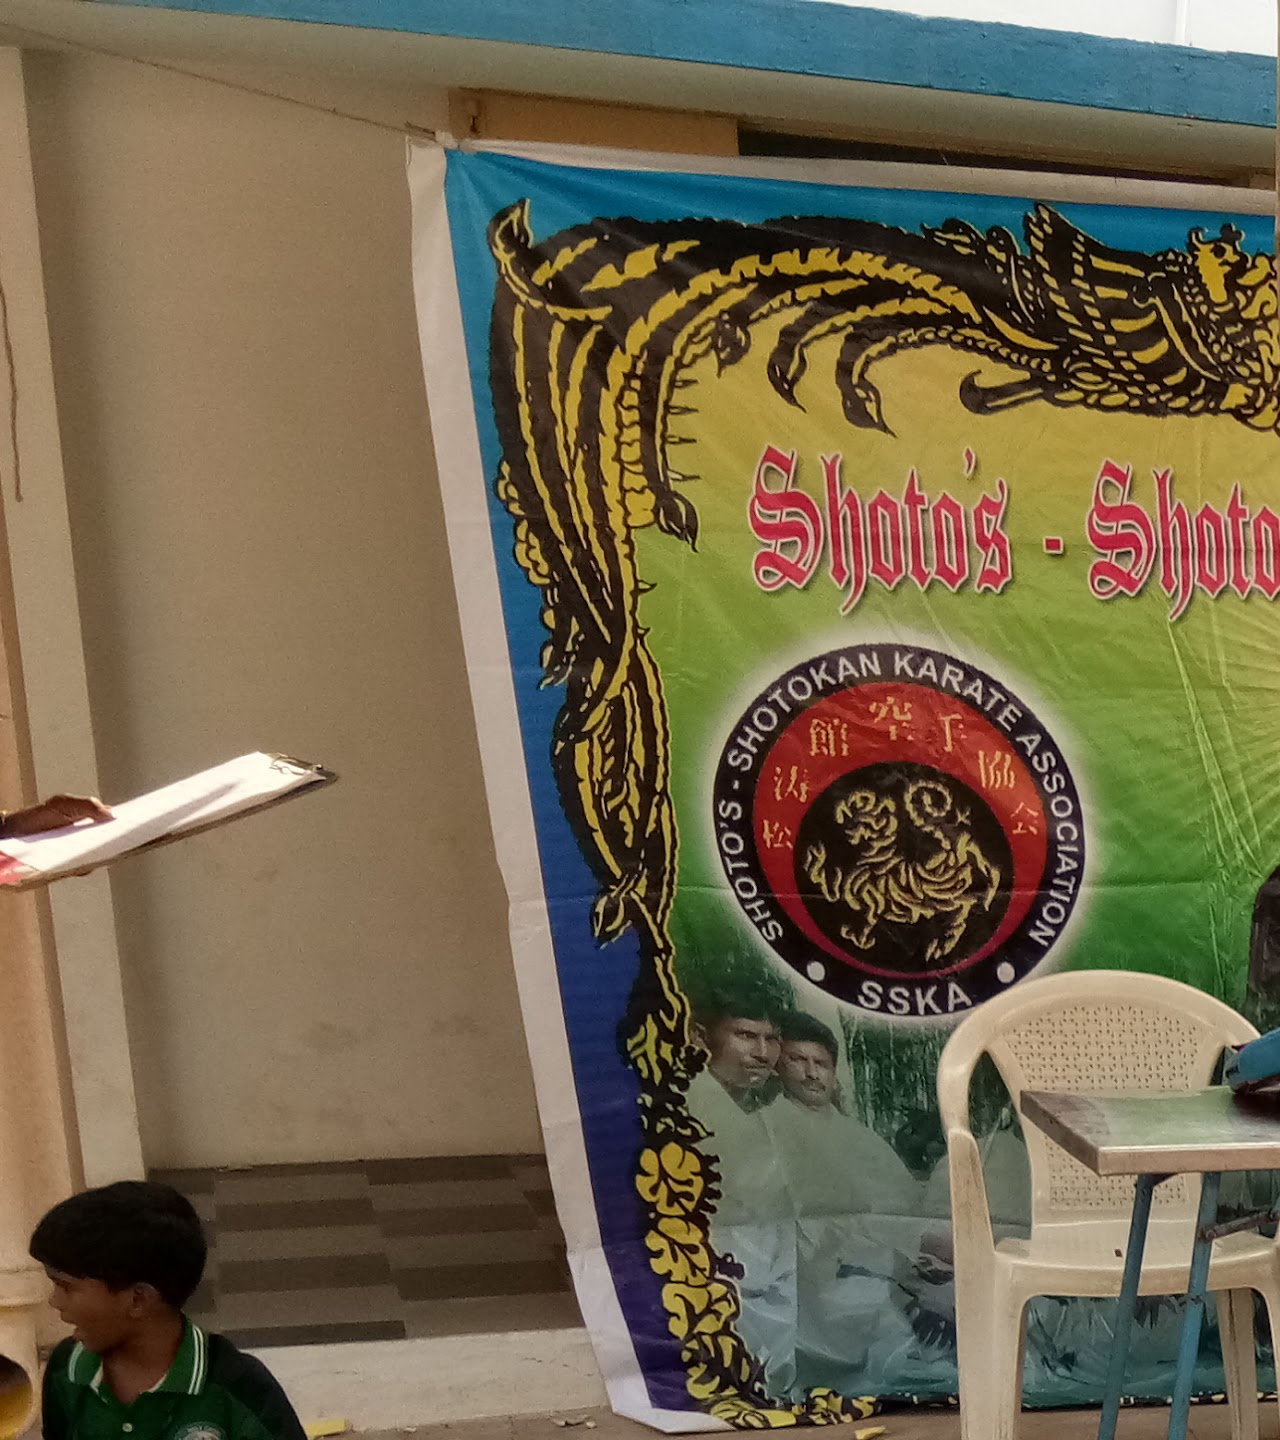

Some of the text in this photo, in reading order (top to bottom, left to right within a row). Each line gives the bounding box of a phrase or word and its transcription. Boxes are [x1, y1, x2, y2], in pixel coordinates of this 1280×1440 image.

[749, 444, 1012, 615] Shoto's
[728, 651, 882, 772] SHOTOKAN
[893, 650, 1024, 732] KARATE
[718, 800, 784, 943] SHOTO'S
[1016, 732, 1080, 948] ASSOCIATION
[857, 980, 973, 1016] SSKA
